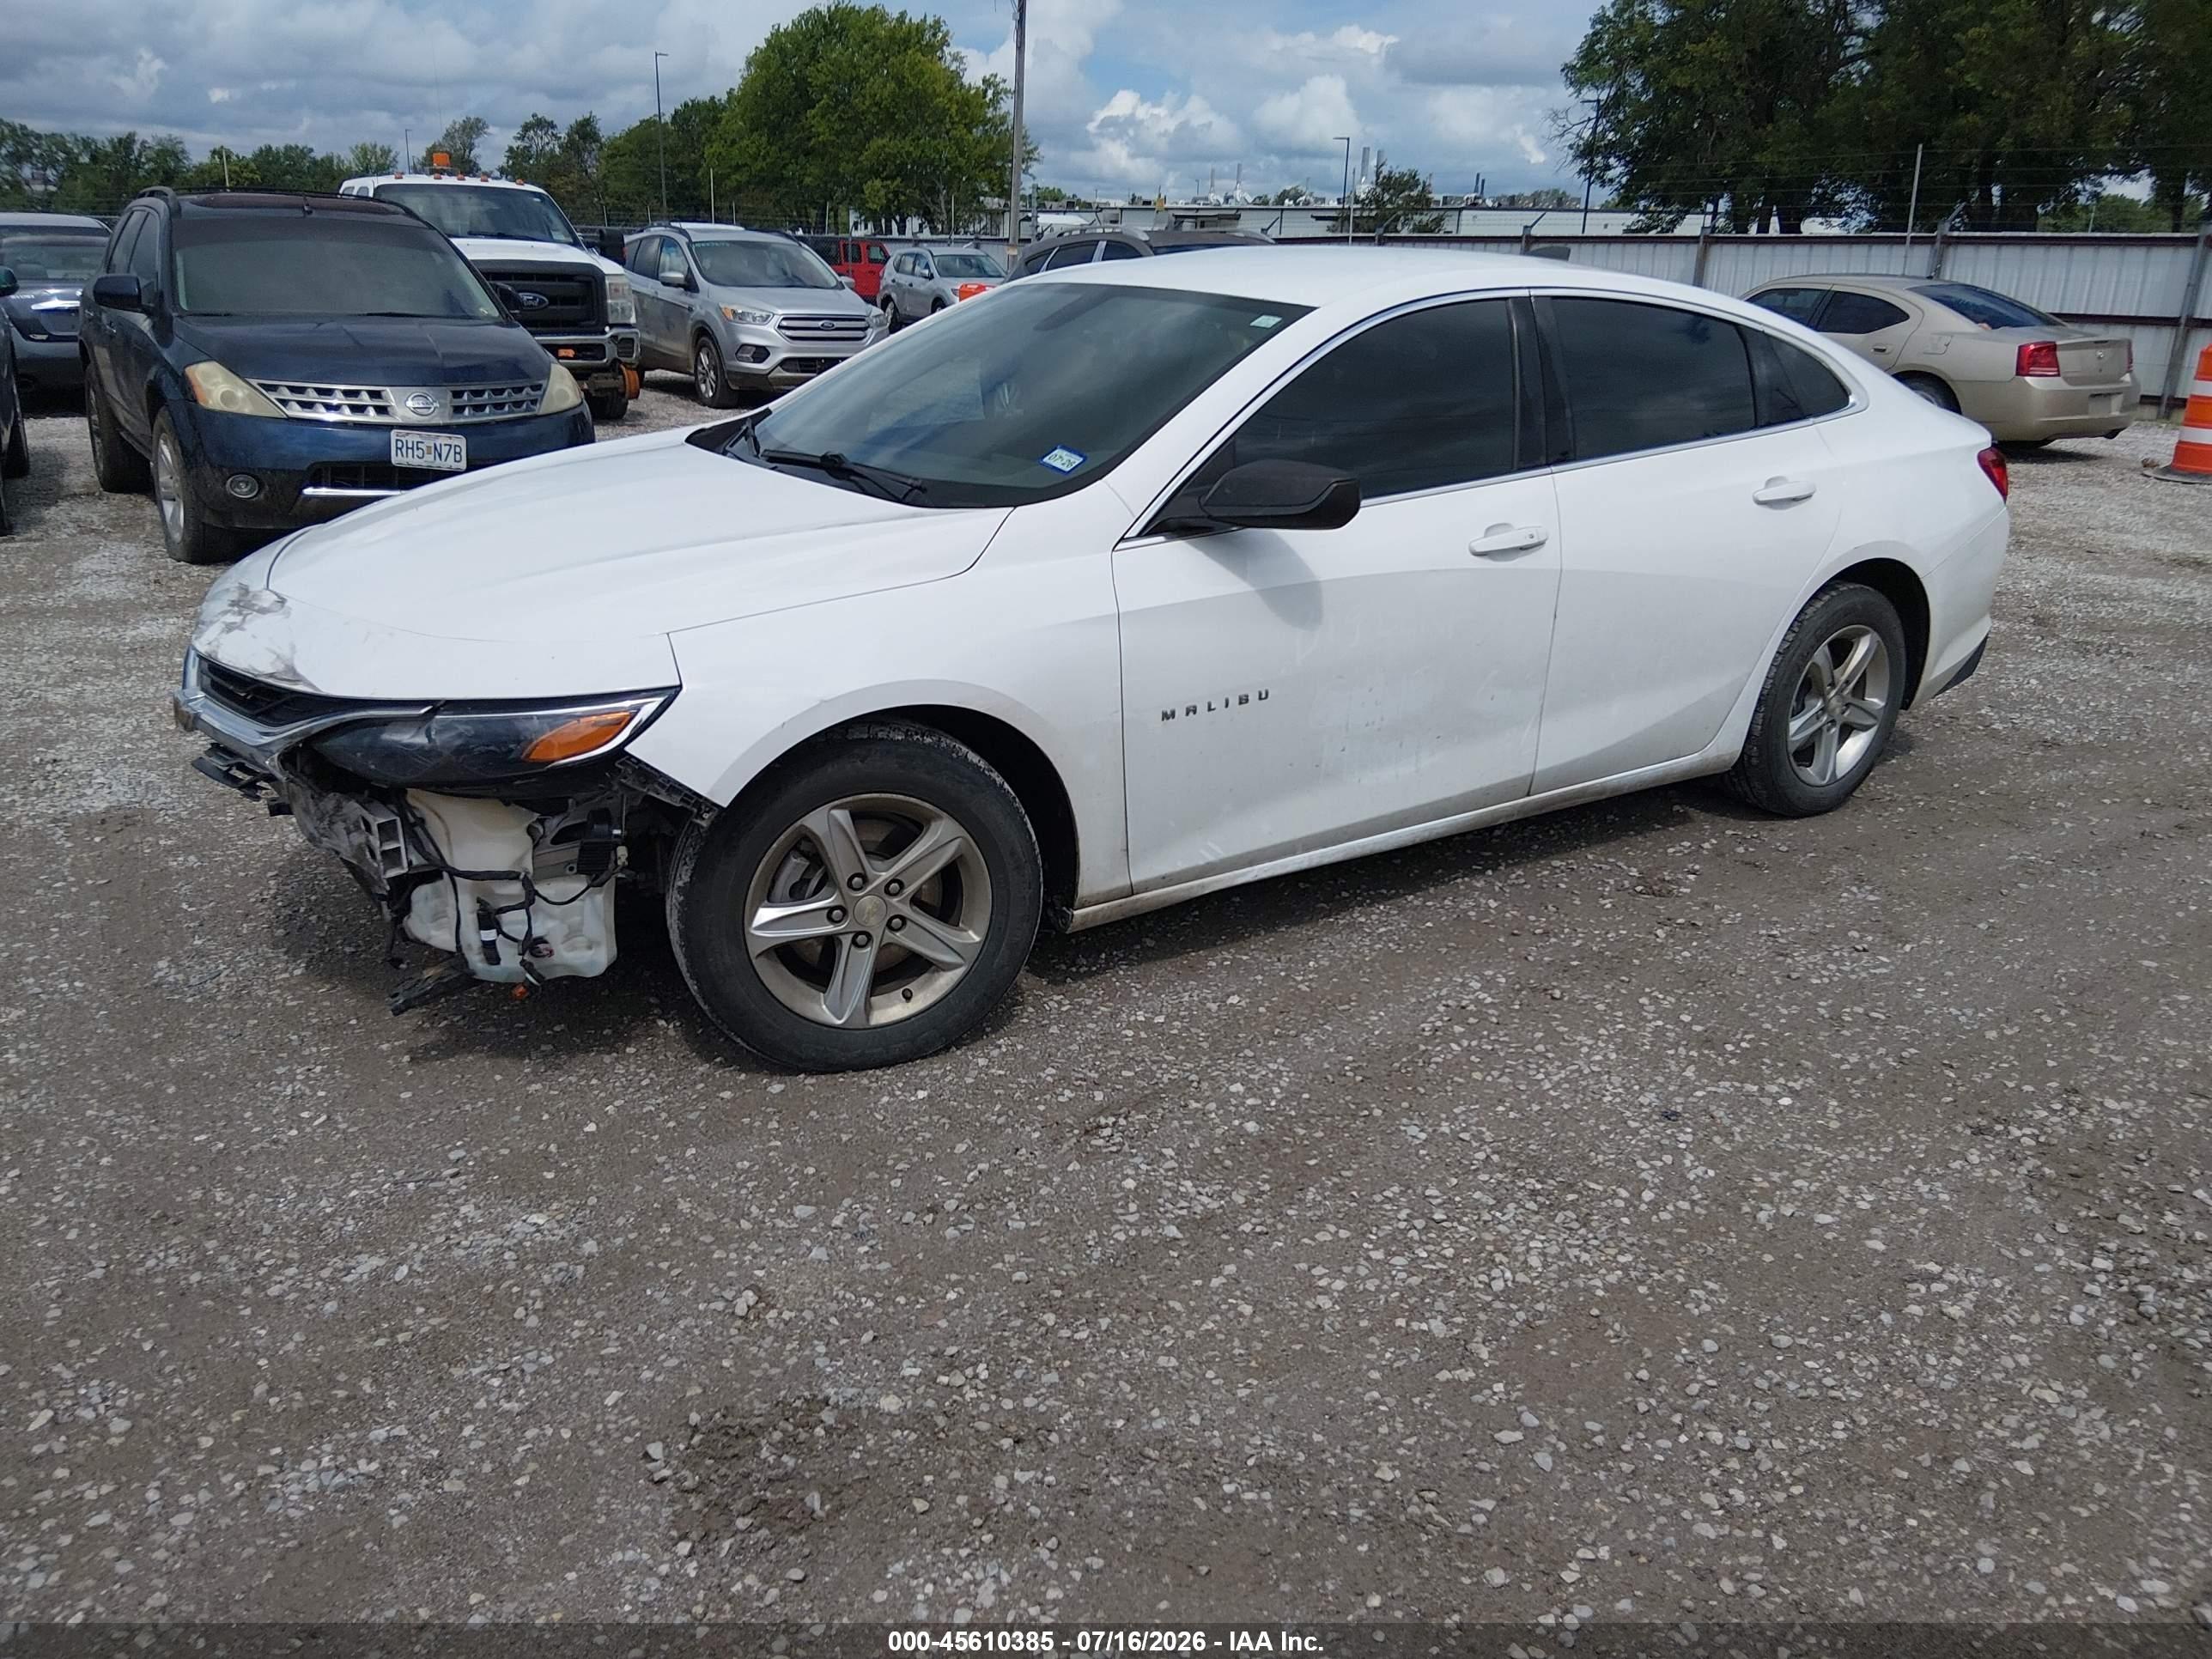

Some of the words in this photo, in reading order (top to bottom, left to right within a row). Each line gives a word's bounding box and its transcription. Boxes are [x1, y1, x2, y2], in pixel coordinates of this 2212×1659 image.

[395, 438, 425, 460] RH5
[433, 442, 463, 464] N7B
[1161, 688, 1270, 722] MALIBU
